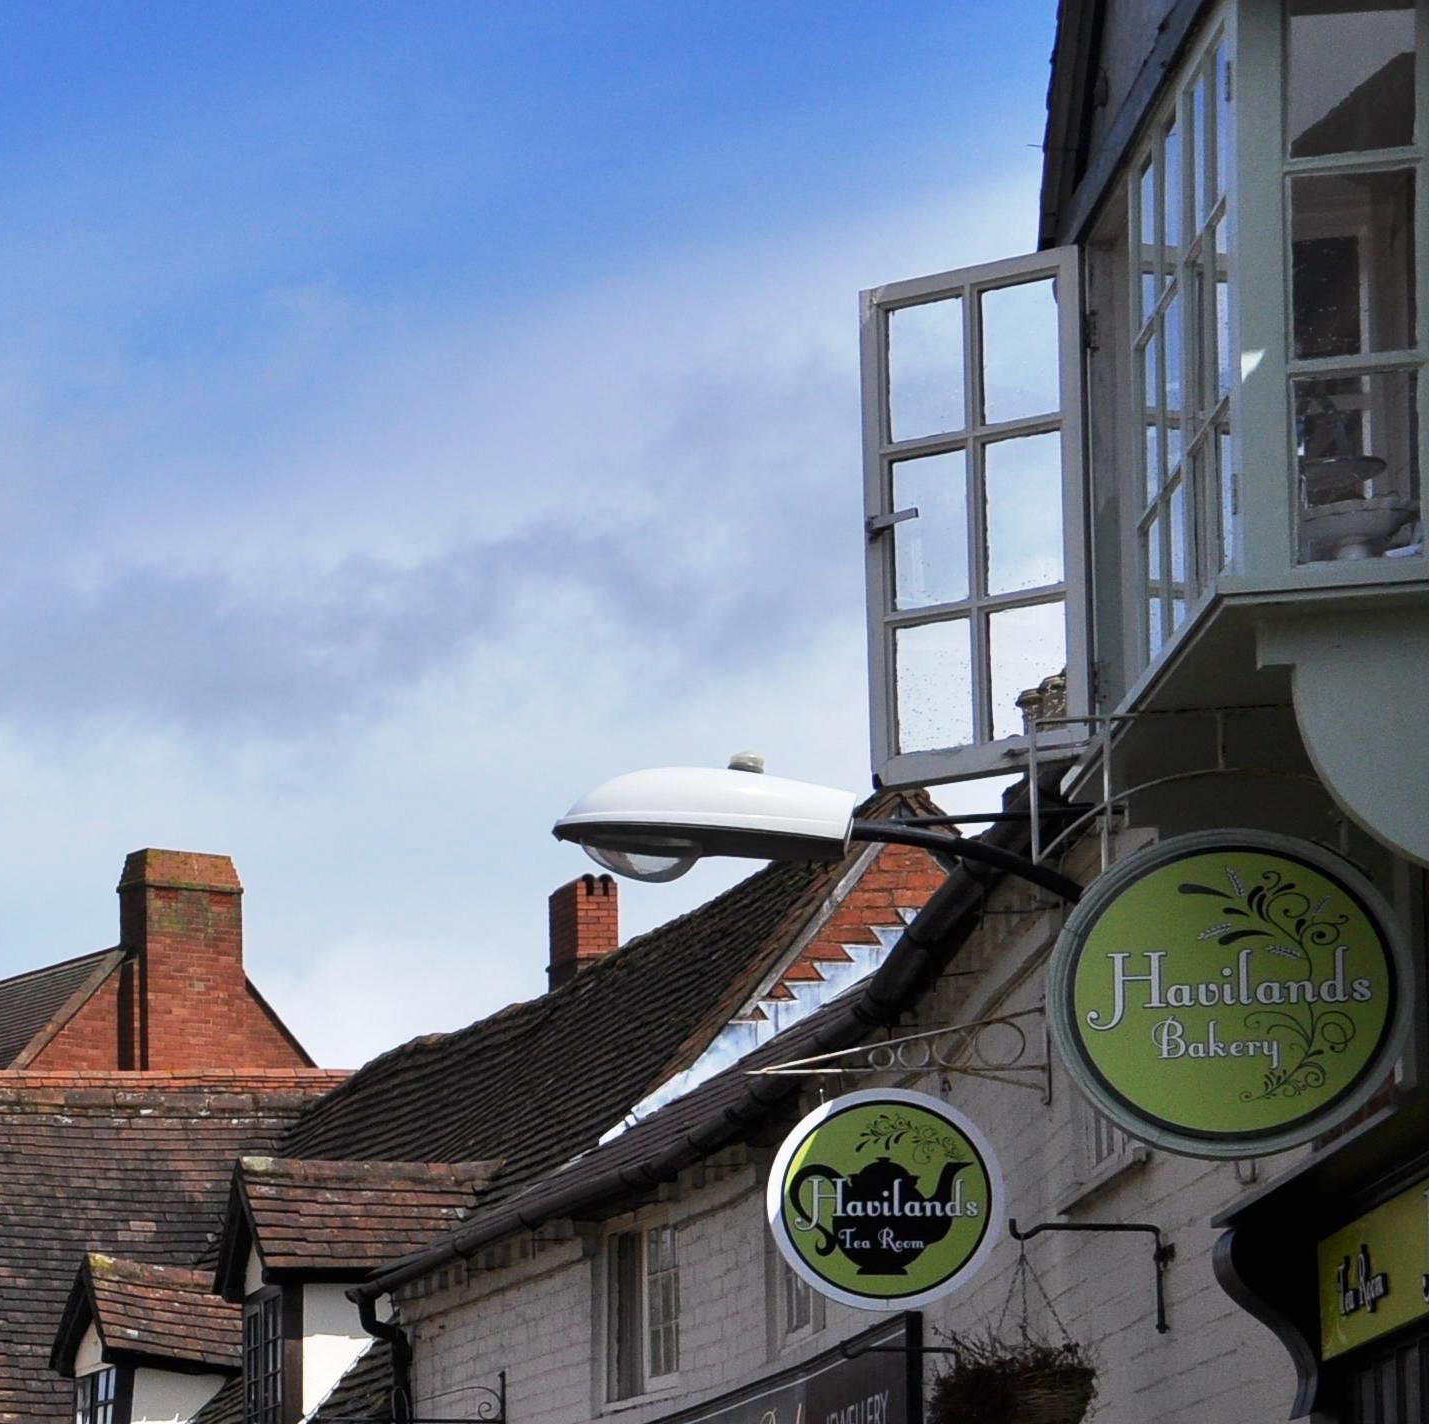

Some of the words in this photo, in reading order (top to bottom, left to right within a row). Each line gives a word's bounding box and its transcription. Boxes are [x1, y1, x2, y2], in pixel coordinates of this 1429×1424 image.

[1086, 946, 1372, 1030] Havilands
[1151, 1016, 1280, 1069] Bakery
[794, 1175, 980, 1231] Havilands
[838, 1228, 872, 1249] Tea
[878, 1226, 925, 1253] Room
